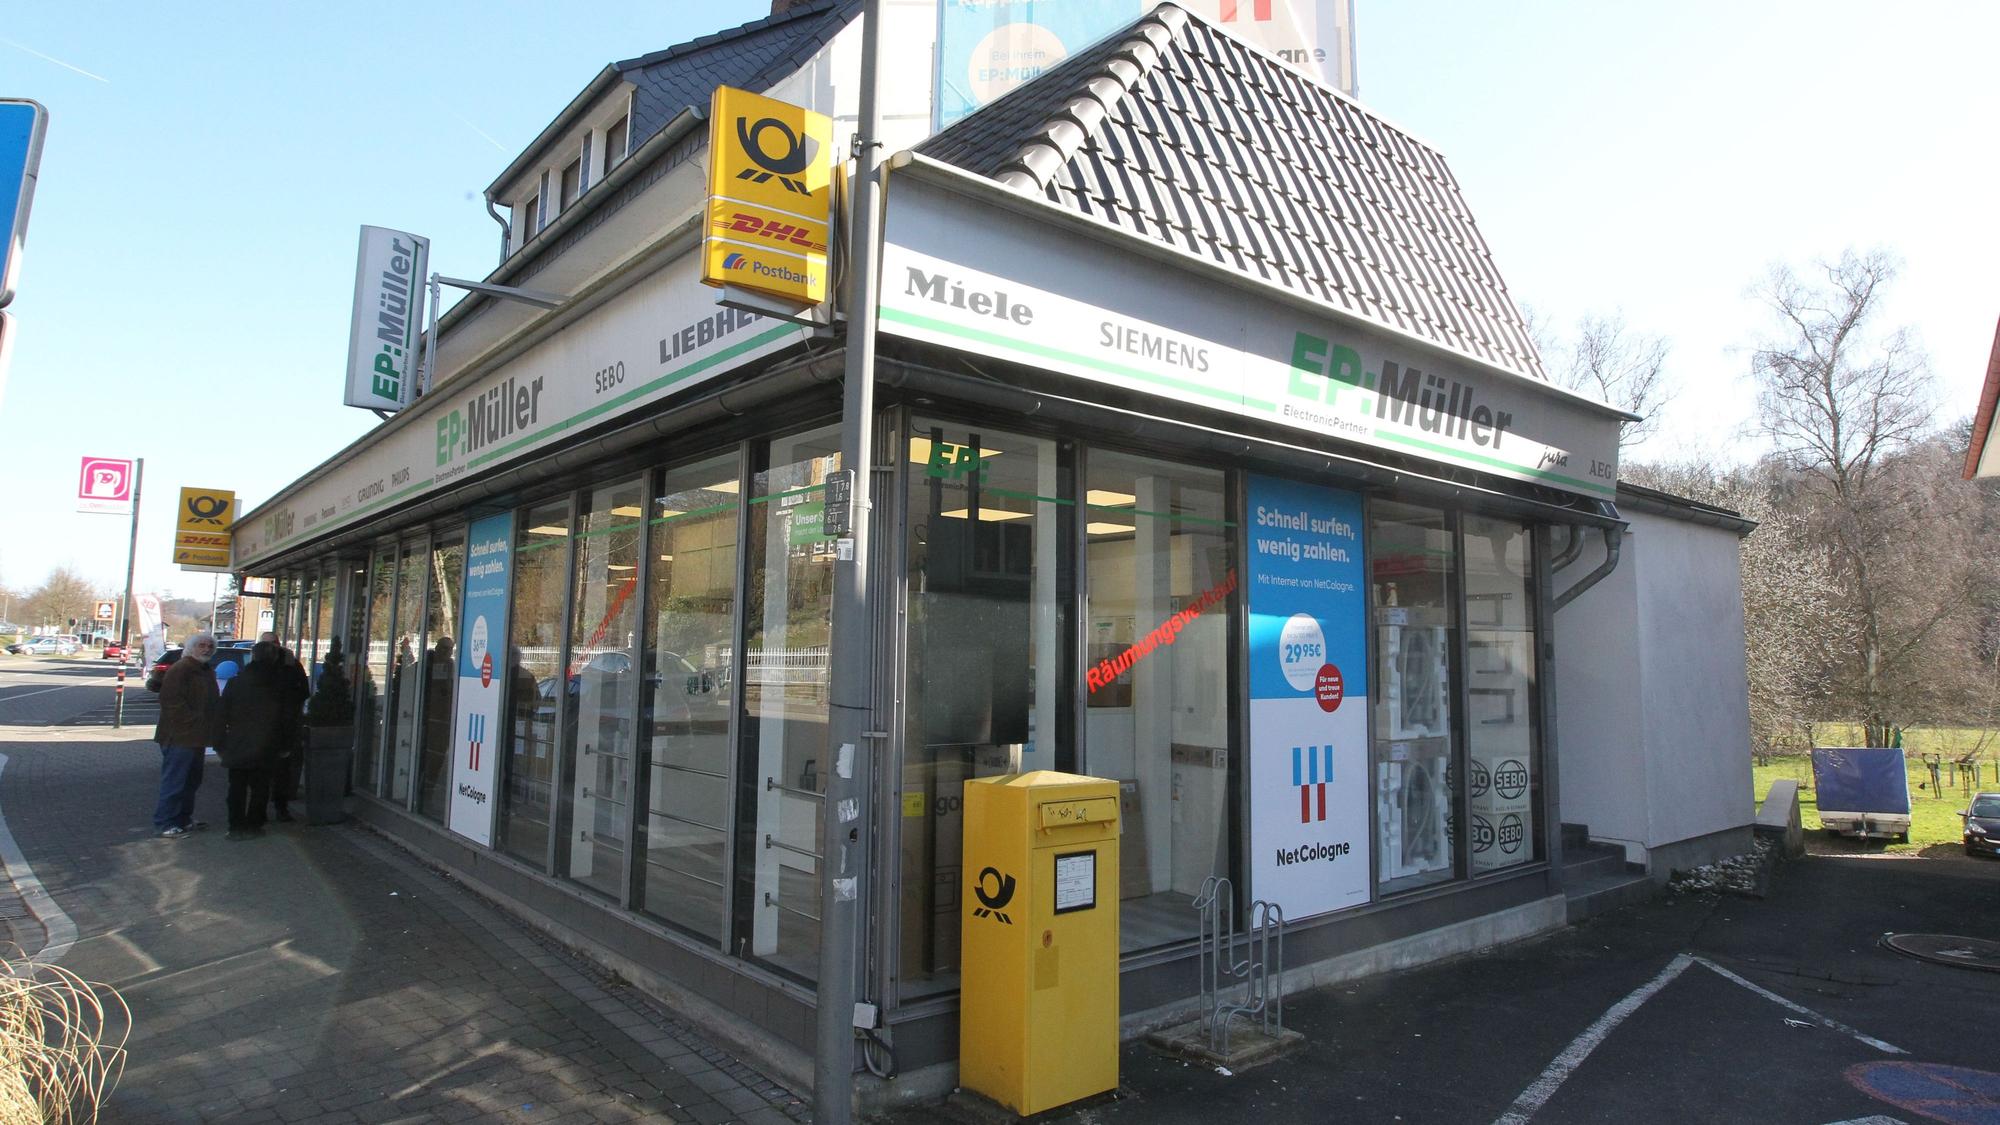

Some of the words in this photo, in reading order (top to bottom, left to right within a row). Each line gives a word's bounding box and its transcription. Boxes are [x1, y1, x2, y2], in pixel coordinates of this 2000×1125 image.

[729, 213, 814, 248] DHL
[753, 261, 816, 286] Postbank
[905, 265, 1033, 326] Miele
[372, 237, 412, 402] EP:Müller
[659, 307, 763, 364] LIEBHE
[1100, 321, 1209, 373] SIEMENS
[595, 360, 626, 394] SEBO
[1287, 331, 1512, 450] EP:Müller
[436, 376, 544, 468] EP:Müller
[1283, 404, 1369, 436] ElectronicPartner
[1536, 446, 1569, 470] jura
[1588, 460, 1613, 480] AEG
[391, 466, 411, 488] PHILIPS
[358, 479, 385, 503] GRUNDIG
[795, 512, 817, 526] Unser
[1257, 506, 1308, 532] Schnell
[1311, 517, 1355, 541] surfen,
[184, 535, 223, 545] DHL
[1257, 537, 1300, 562] wenig
[1303, 542, 1350, 564] zahlen.
[1257, 573, 1270, 584] Mit
[1271, 575, 1299, 587] Internet
[1300, 579, 1313, 588] von
[1086, 567, 1238, 694] Räumungsverkauf
[1496, 771, 1526, 788] SEBO
[458, 782, 486, 804] NetCologne
[1499, 825, 1522, 844] SEBO
[1276, 842, 1350, 867] NetCologne
